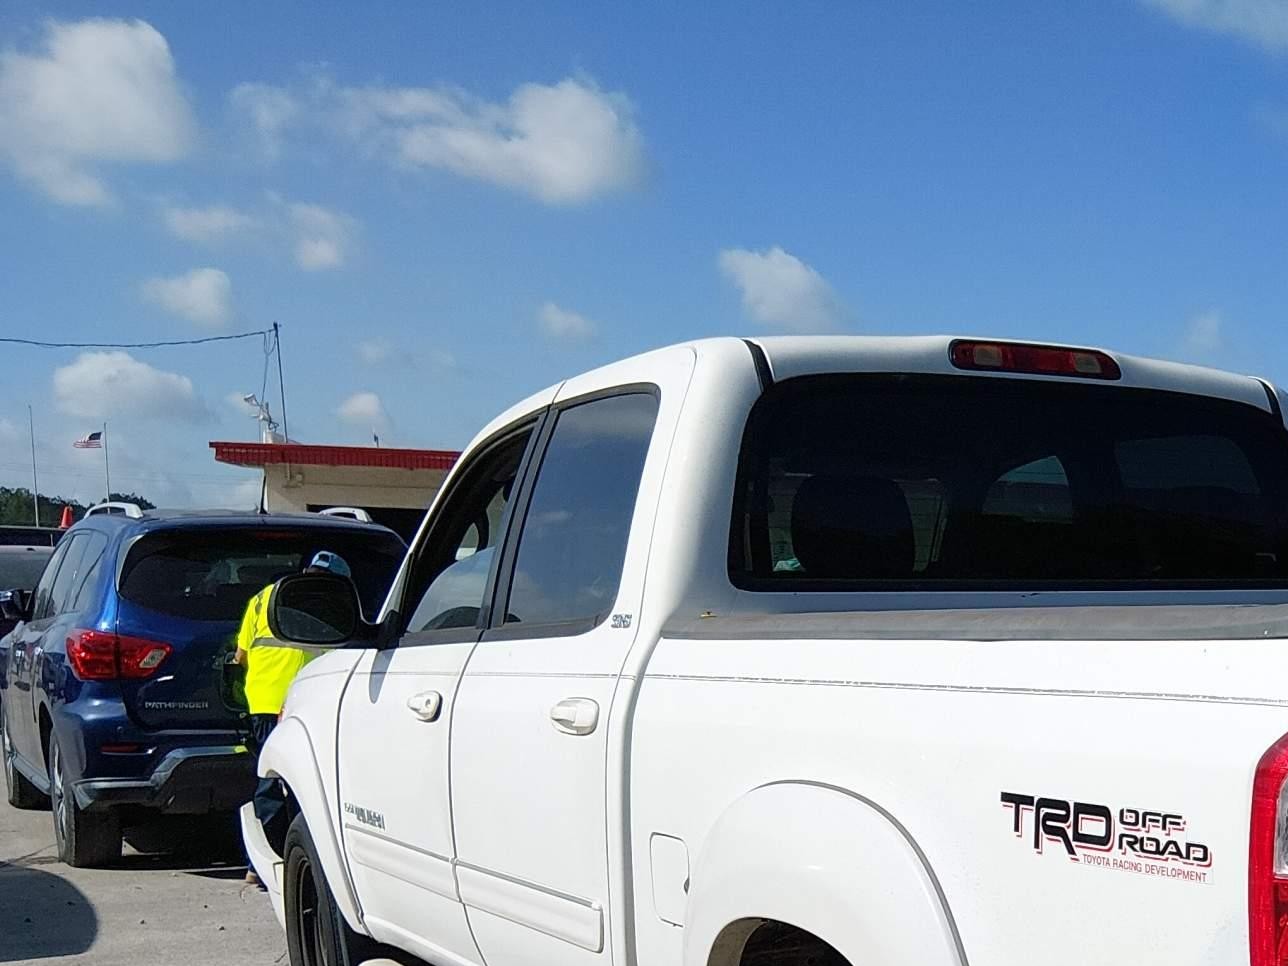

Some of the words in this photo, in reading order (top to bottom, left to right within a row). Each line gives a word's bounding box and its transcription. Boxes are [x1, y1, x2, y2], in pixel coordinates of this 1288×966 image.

[1001, 791, 1116, 865] TRD
[1119, 808, 1187, 835] OFF
[1118, 833, 1212, 867] ROAD
[1083, 853, 1110, 867] TOYOTA
[1112, 858, 1142, 872] RACING
[1145, 864, 1207, 882] DEVELOPMENT
